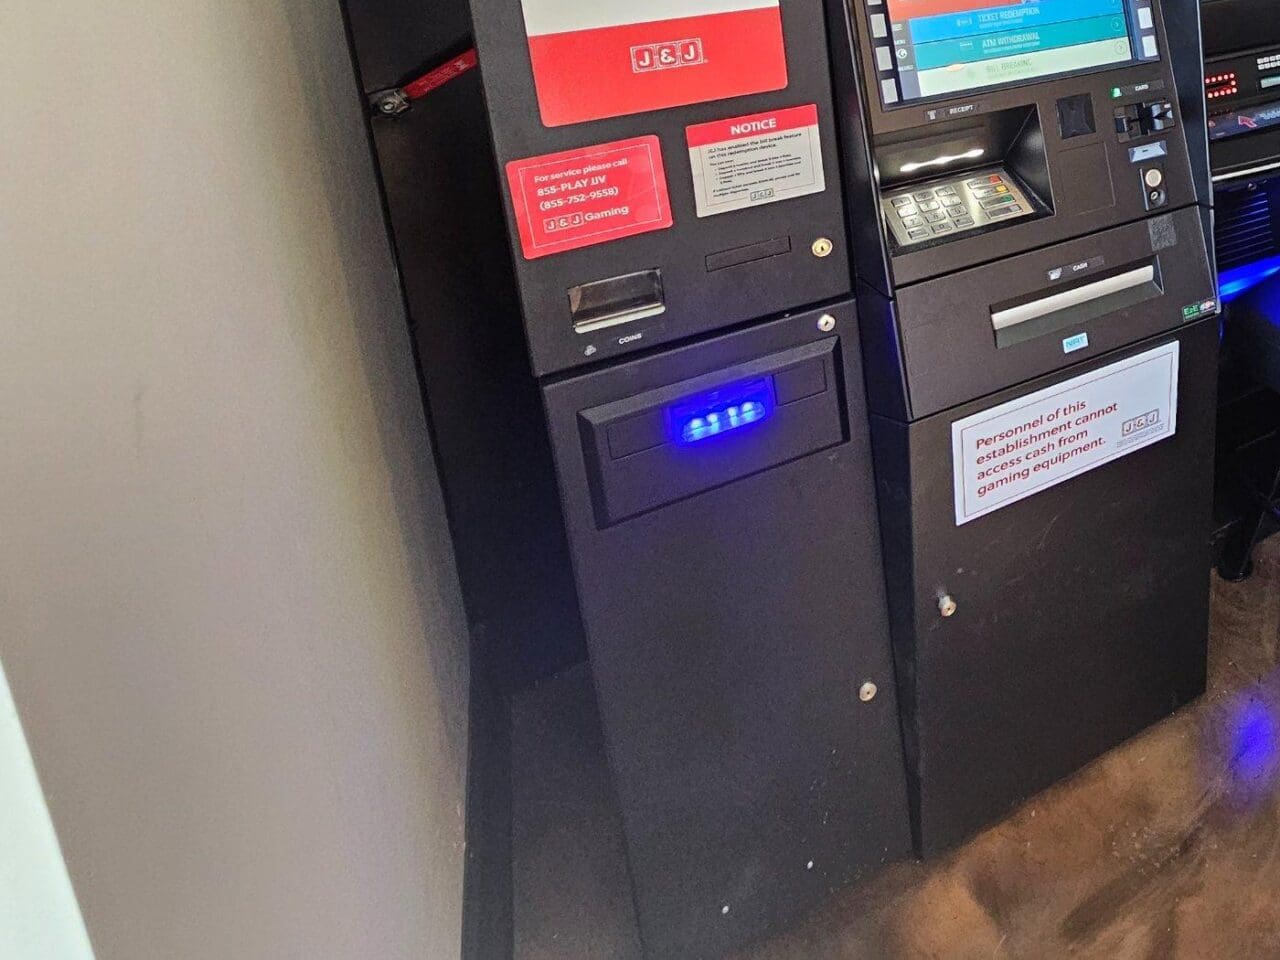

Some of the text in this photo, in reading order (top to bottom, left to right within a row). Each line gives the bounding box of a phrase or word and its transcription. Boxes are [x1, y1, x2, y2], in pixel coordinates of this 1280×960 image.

[977, 6, 1040, 23] TICKET REDEMPTION
[982, 39, 997, 49] ATM
[998, 32, 1040, 46] WITHDRAWAL
[633, 40, 701, 71] J&J
[949, 104, 973, 115] RECEIPT
[730, 118, 777, 135] NOTICE
[535, 158, 628, 183] For service please call
[537, 179, 588, 197] 855-PLAY
[539, 186, 619, 212] (855-752-9558)
[545, 206, 629, 232] J&J Gaming
[1072, 262, 1088, 272] CASH
[976, 400, 1087, 450] Personnel of this
[976, 403, 1118, 465] establishment cannot
[977, 428, 1089, 480] access cash from
[977, 440, 1106, 498] gaming equipment.
